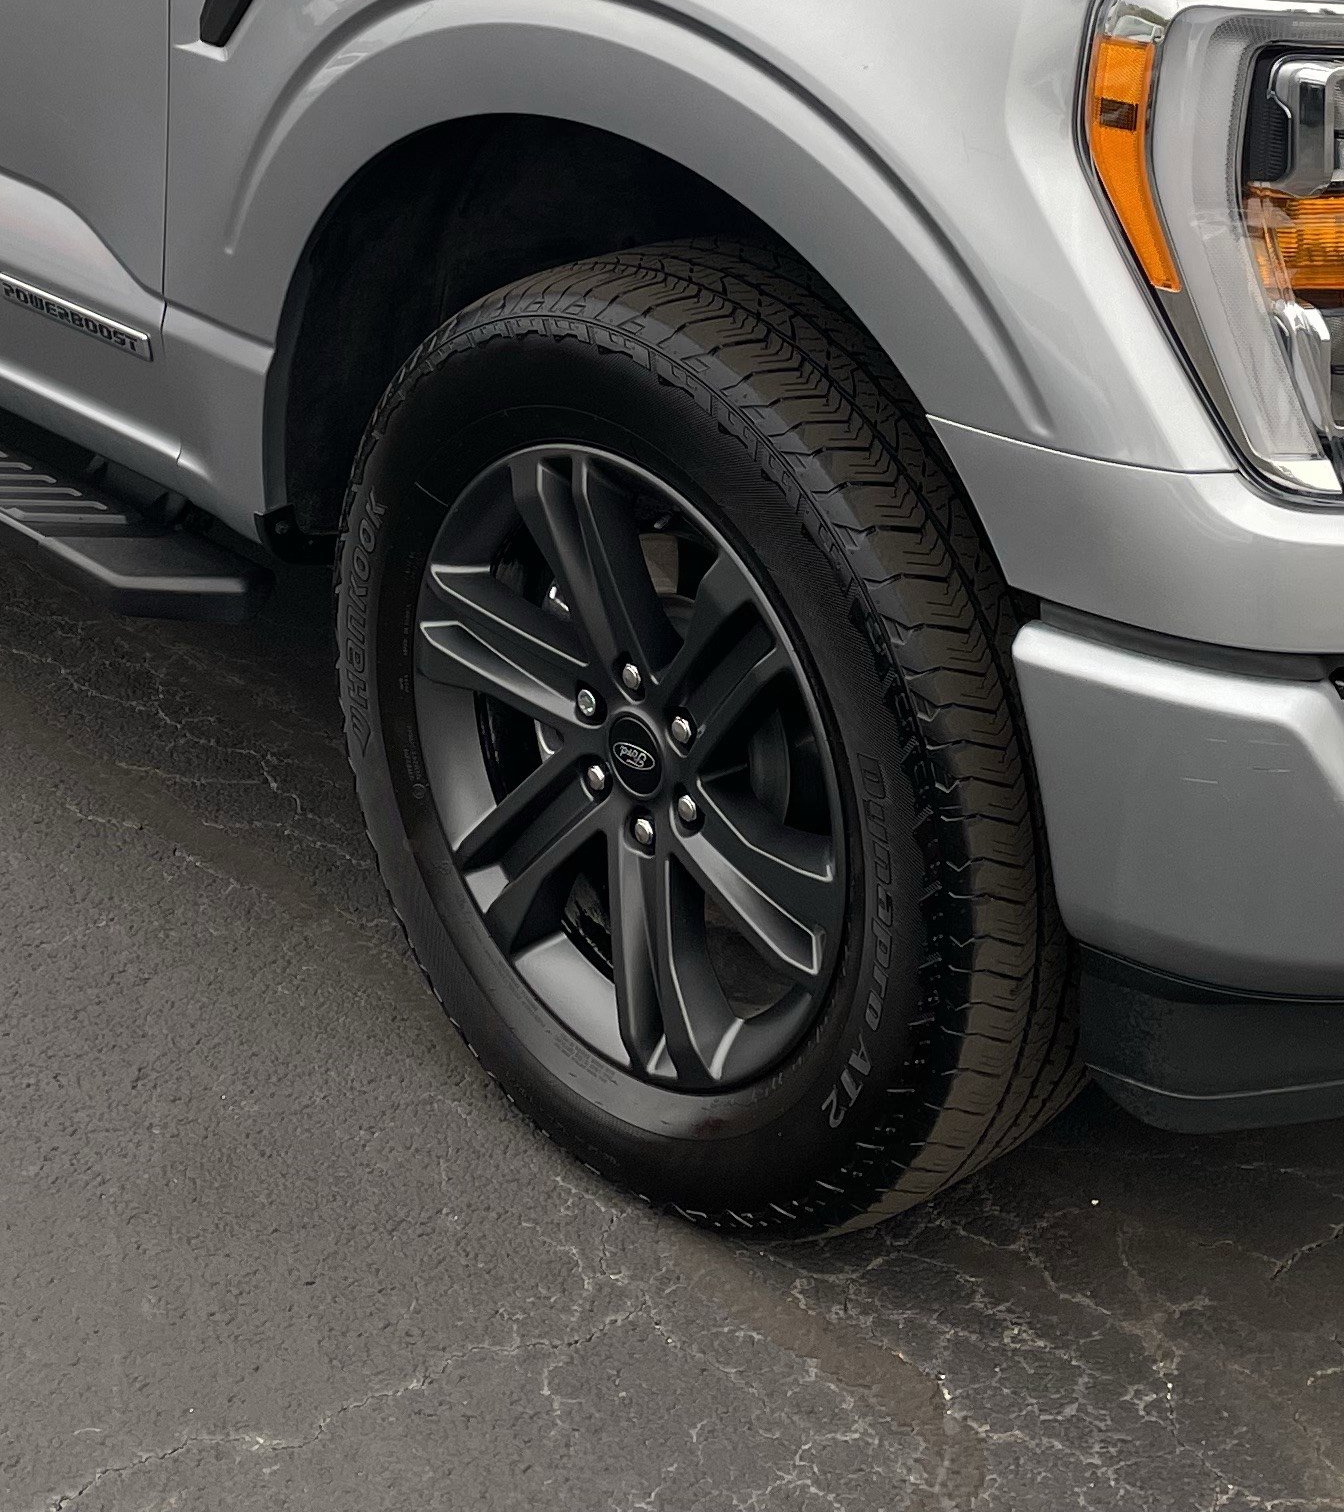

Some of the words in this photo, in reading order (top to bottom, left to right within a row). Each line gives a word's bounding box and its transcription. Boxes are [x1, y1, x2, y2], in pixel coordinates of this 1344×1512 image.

[3, 282, 139, 353] POWERBOOST
[619, 745, 648, 768] Ford
[819, 1032, 874, 1129] AT2
